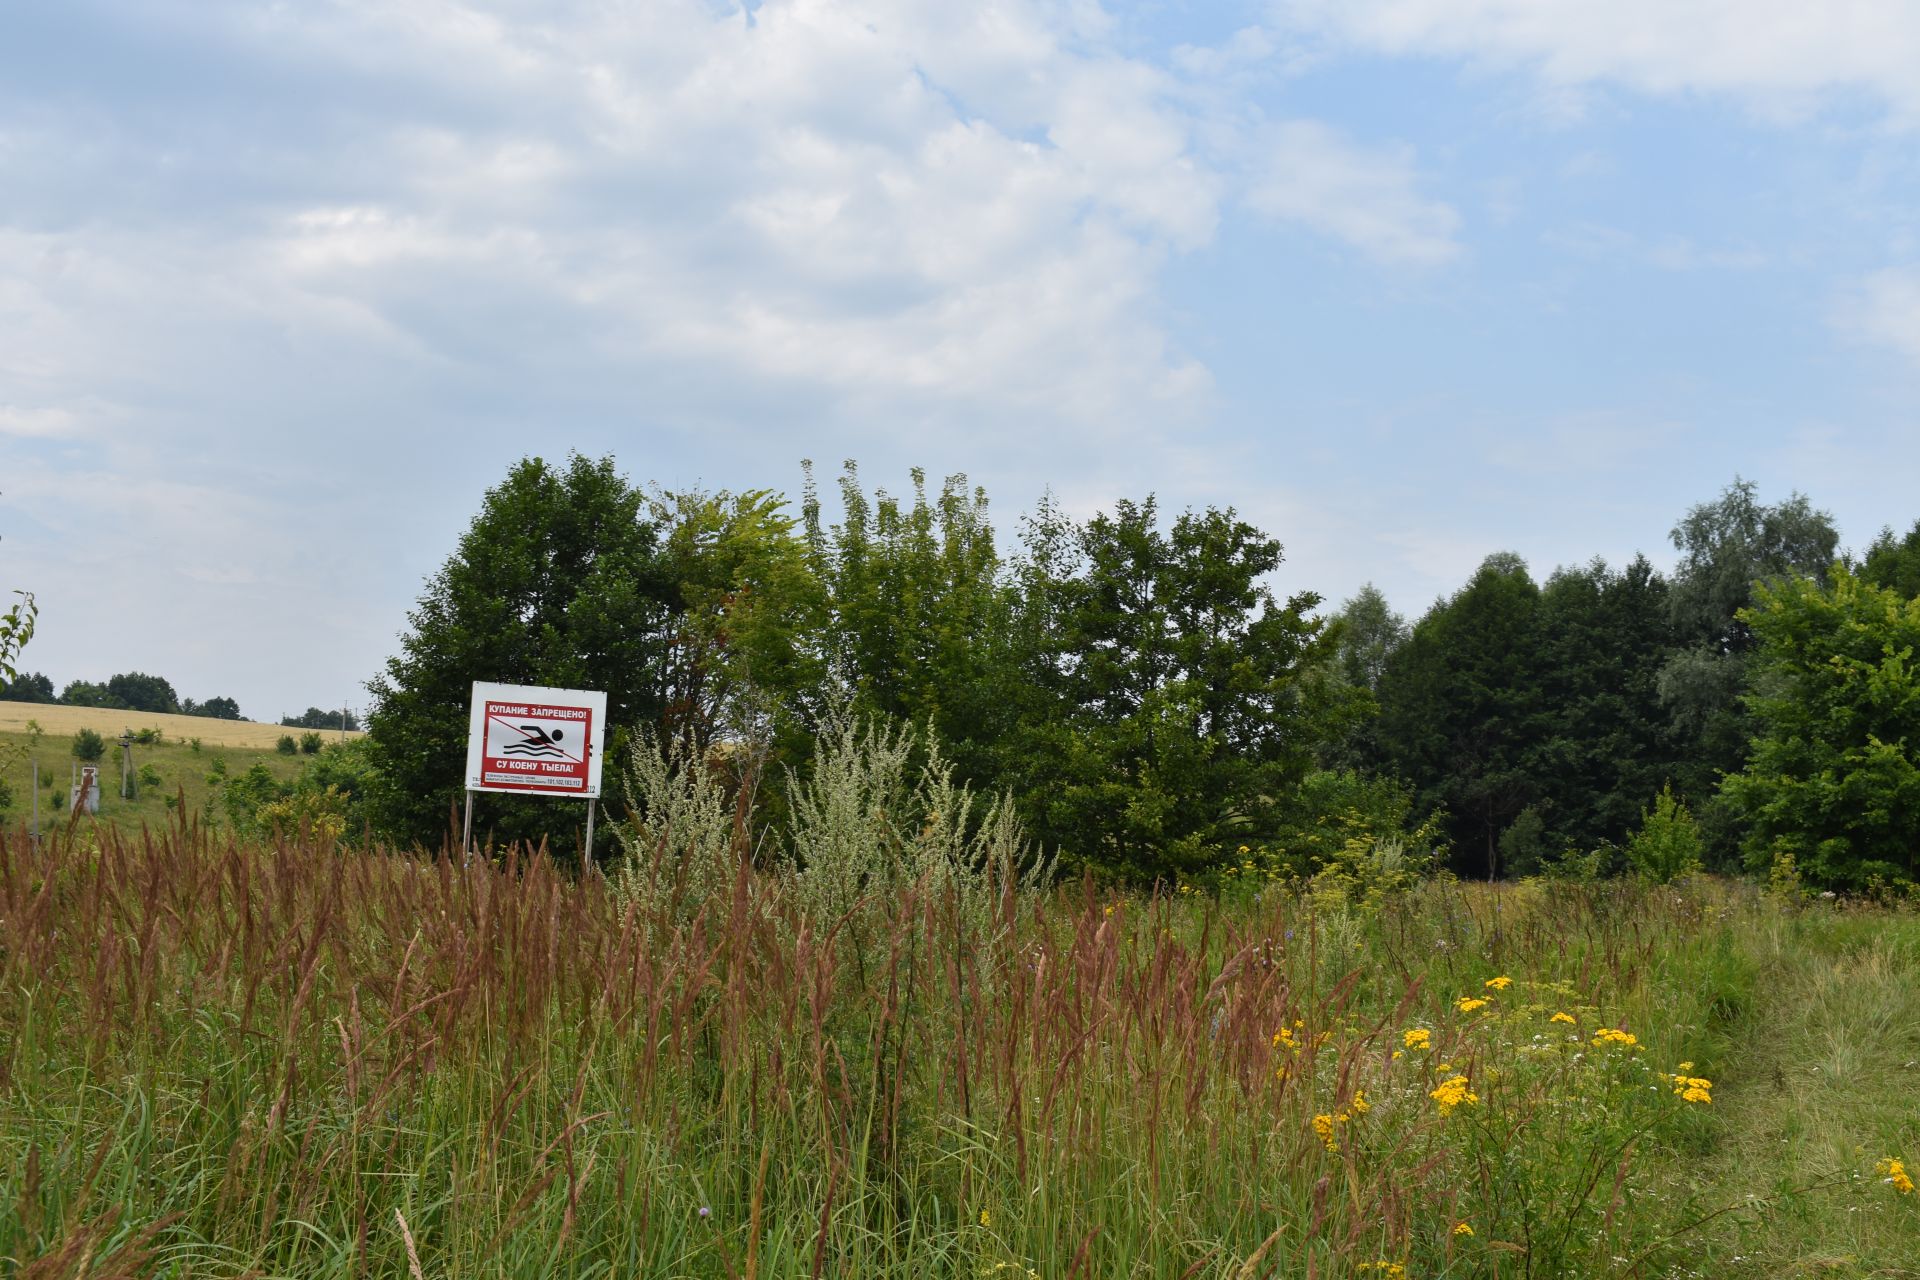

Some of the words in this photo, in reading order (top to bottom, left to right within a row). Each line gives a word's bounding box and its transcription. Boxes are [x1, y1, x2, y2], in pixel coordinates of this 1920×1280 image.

[489, 705, 528, 715] КУПАНИЕ
[531, 708, 587, 719] ЗАПРЕЩЕНО!
[496, 761, 508, 769] СУ
[510, 761, 538, 771] КОЕНУ
[541, 763, 574, 773] ТЫЕЛА!
